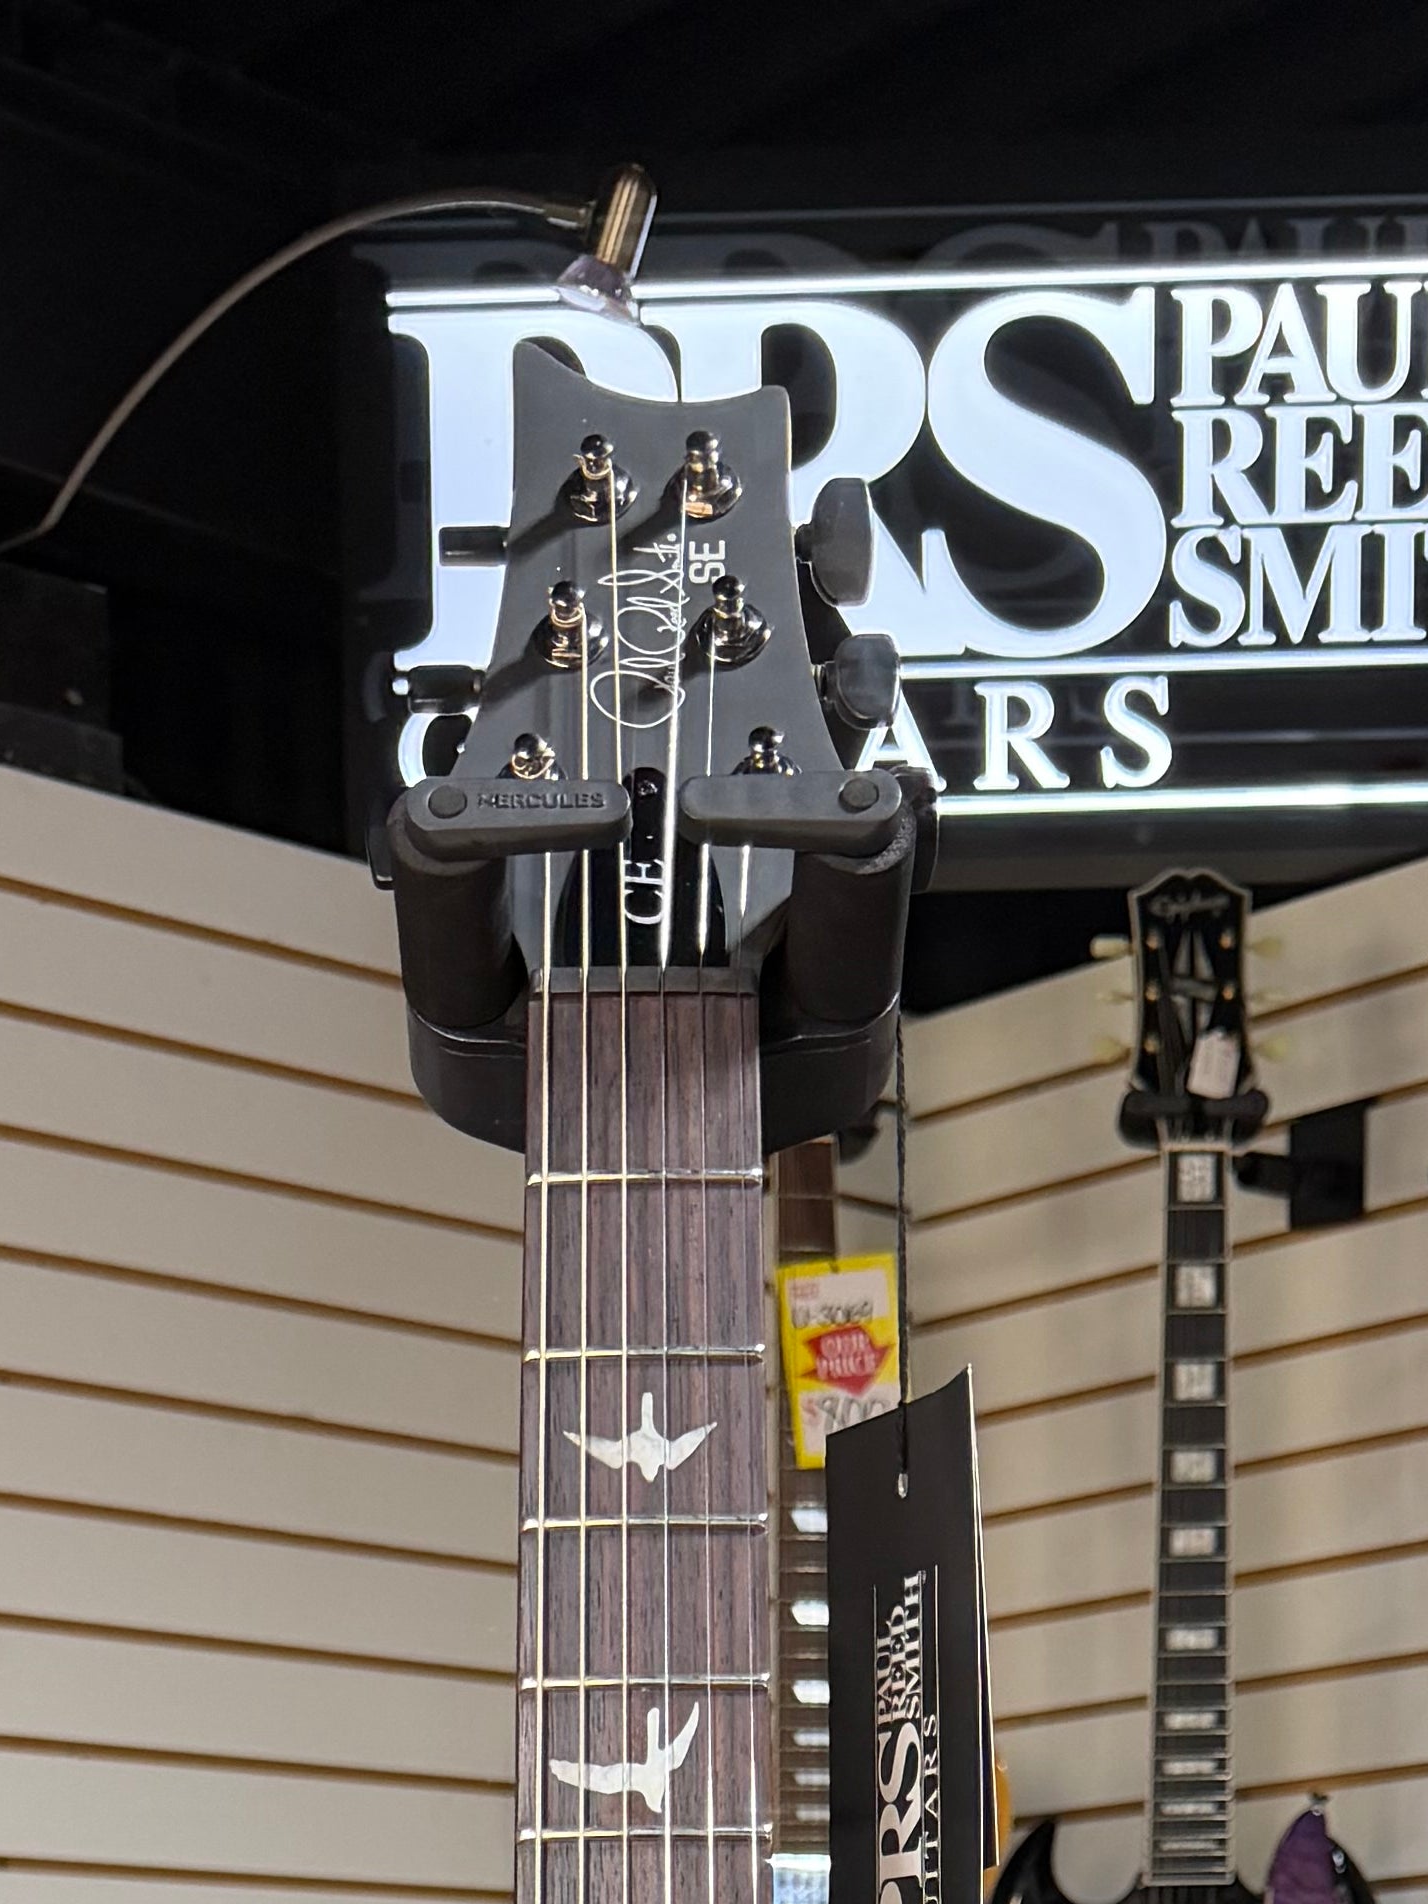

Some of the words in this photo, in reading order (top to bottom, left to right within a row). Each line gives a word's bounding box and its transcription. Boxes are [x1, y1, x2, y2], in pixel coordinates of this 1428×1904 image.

[688, 539, 726, 584] SE
[476, 791, 607, 810] HERCULES
[623, 858, 666, 926] CE
[815, 1349, 878, 1381] PRICE
[876, 1620, 892, 1725] PAUL
[889, 1604, 906, 1722] REED
[903, 1574, 921, 1720] SMITH
